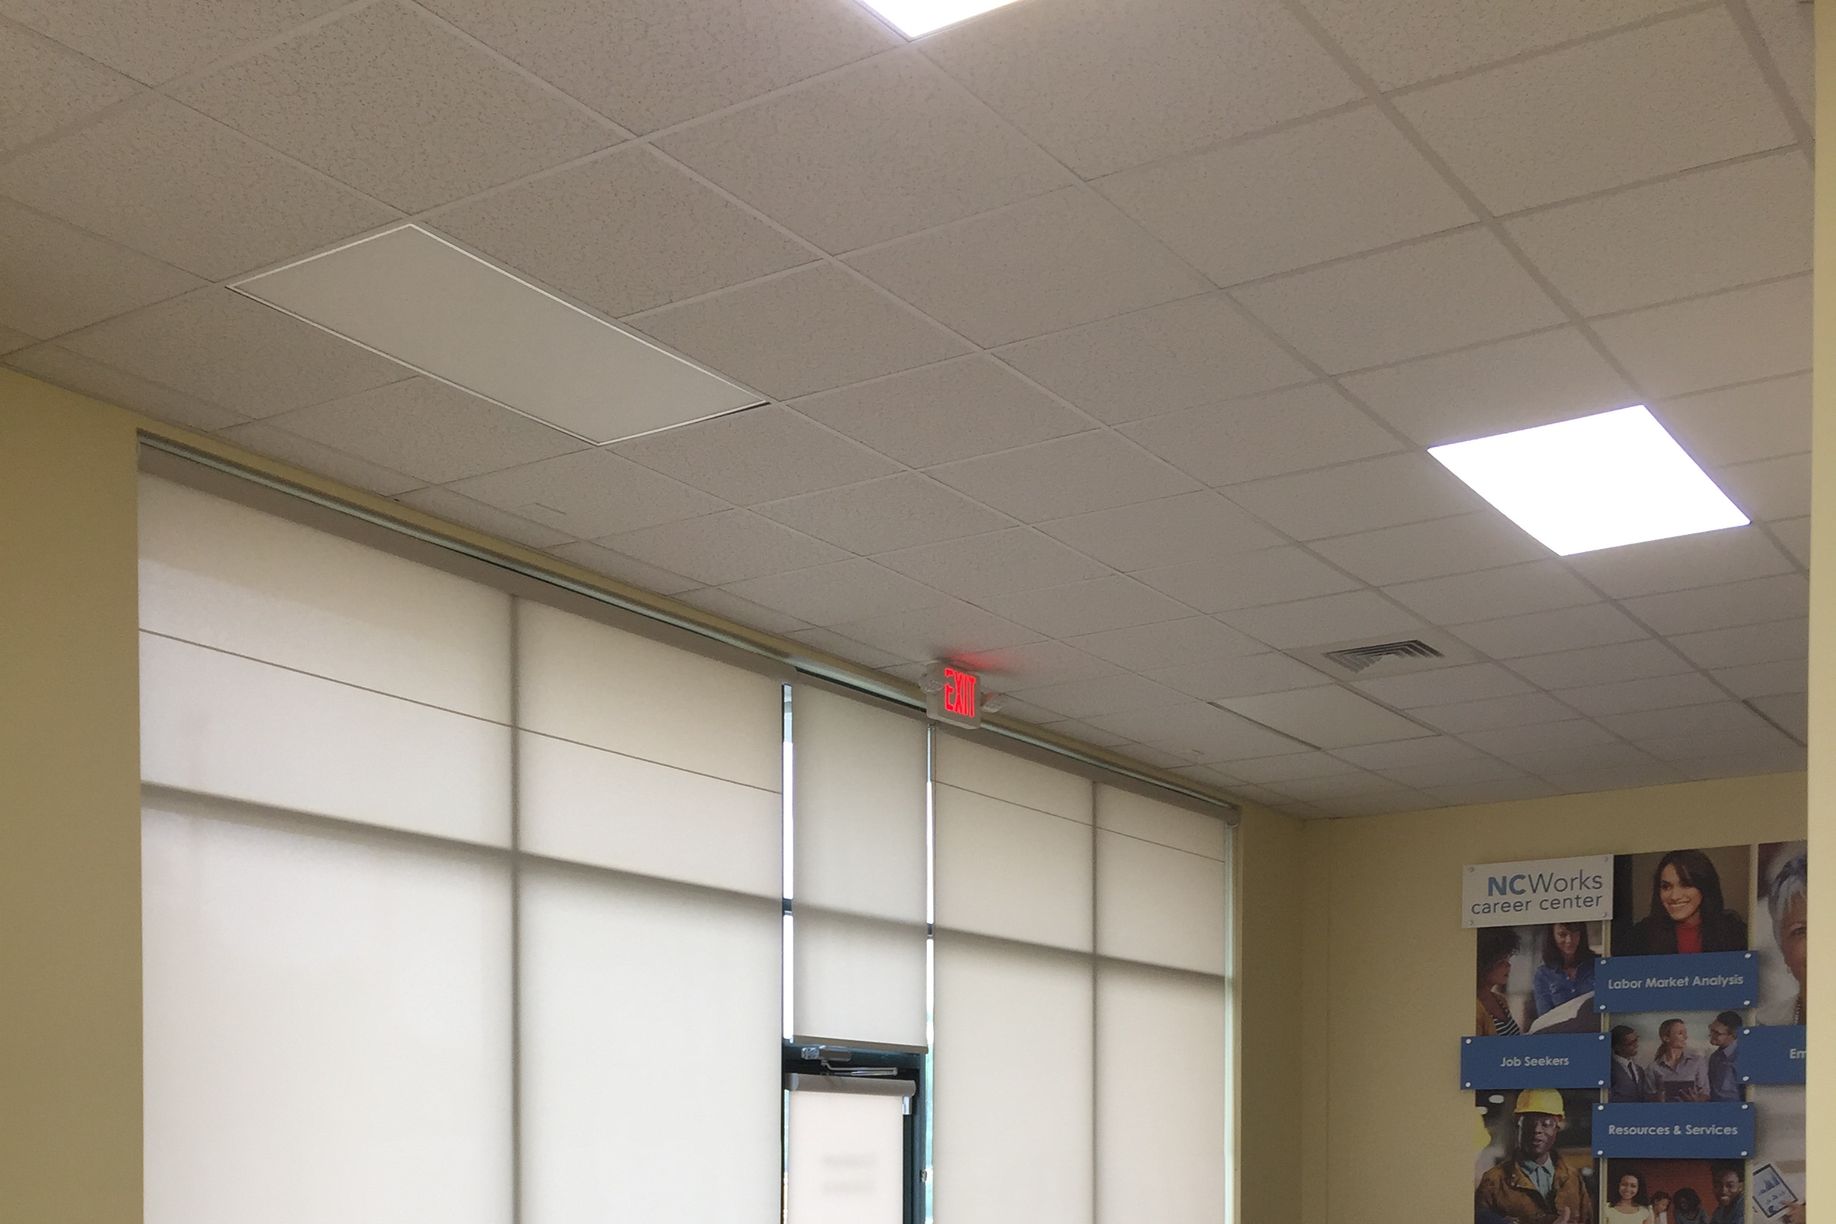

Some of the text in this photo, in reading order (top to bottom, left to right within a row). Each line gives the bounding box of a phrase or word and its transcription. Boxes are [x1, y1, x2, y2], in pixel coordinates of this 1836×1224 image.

[944, 667, 976, 718] EXIT
[1487, 869, 1603, 897] NCWorks
[1471, 894, 1603, 915] career center
[1608, 974, 1744, 989] Labor Market Analysis
[1500, 1056, 1569, 1067] Job Seekers
[1608, 1124, 1738, 1135] Resources & Services
